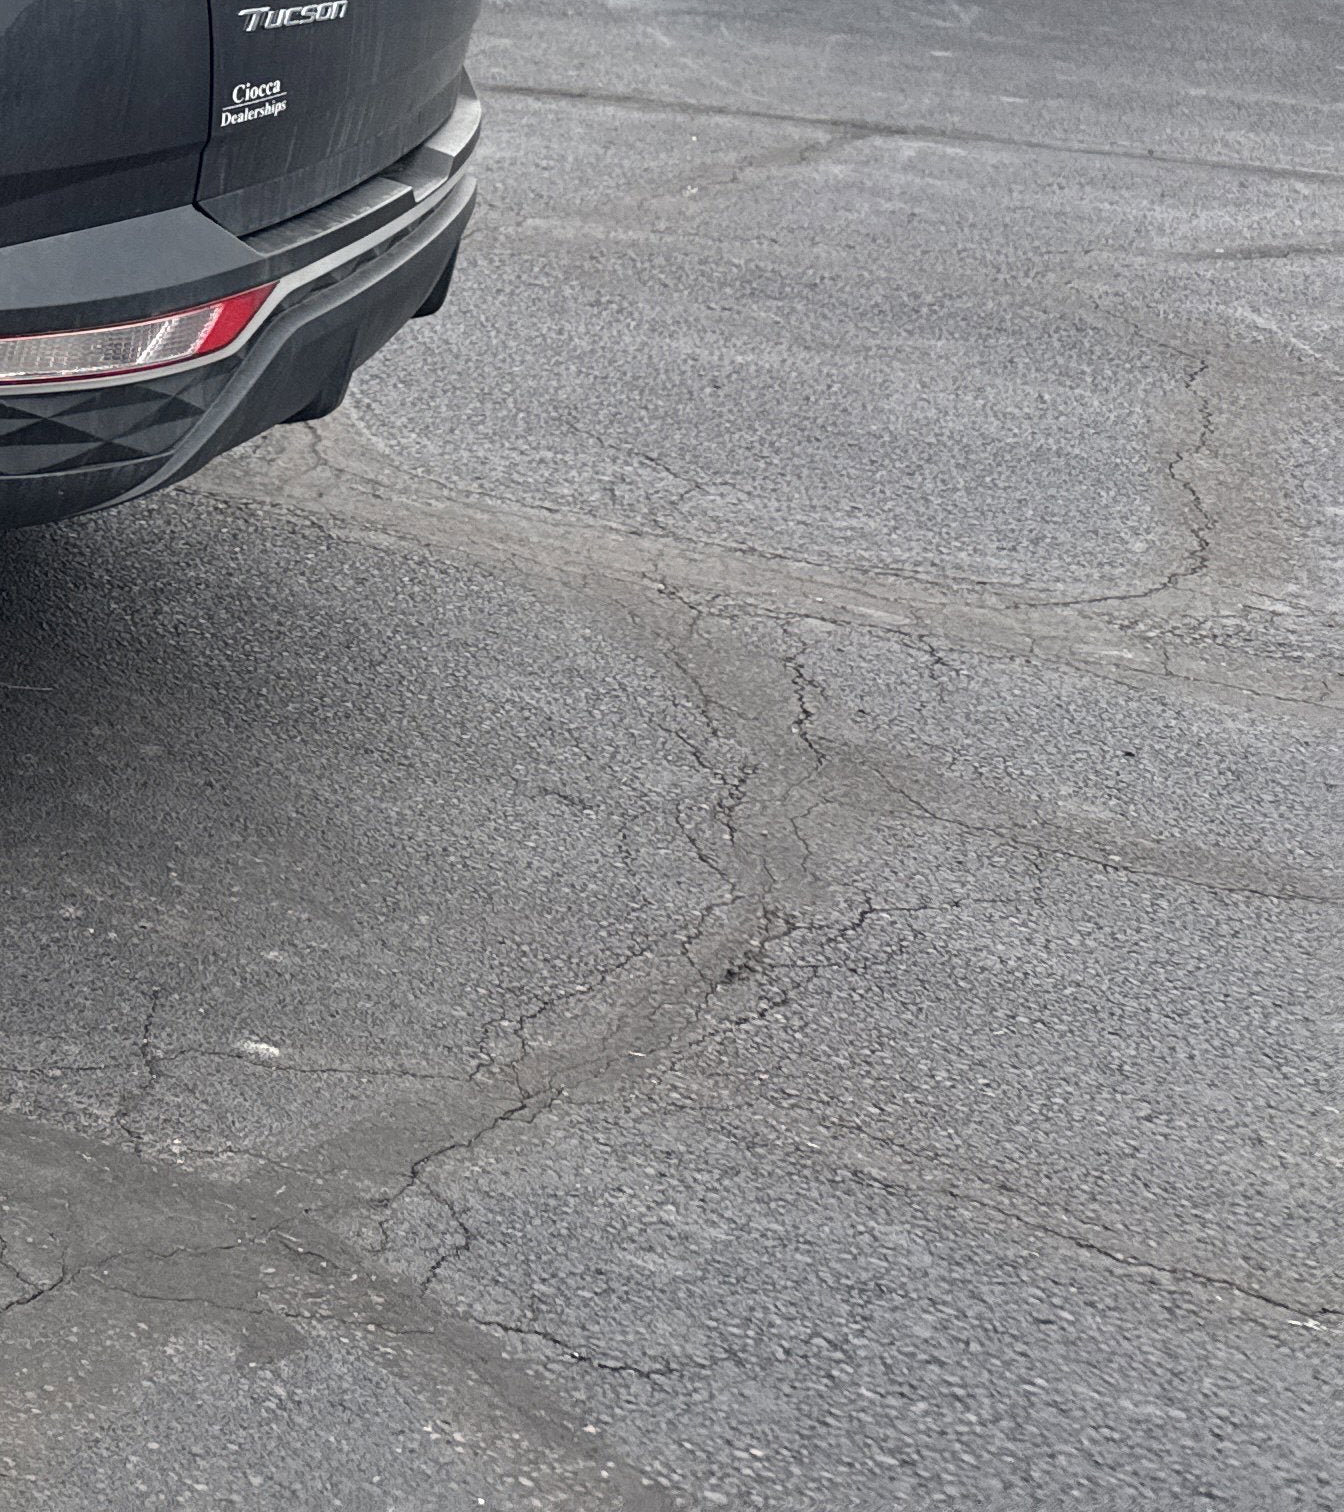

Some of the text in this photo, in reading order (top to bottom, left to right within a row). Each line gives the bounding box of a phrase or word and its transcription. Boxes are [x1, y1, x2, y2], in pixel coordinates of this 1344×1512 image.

[238, 0, 349, 32] Tucson
[232, 79, 281, 104] Ciocca
[220, 99, 287, 128] Dealerships
